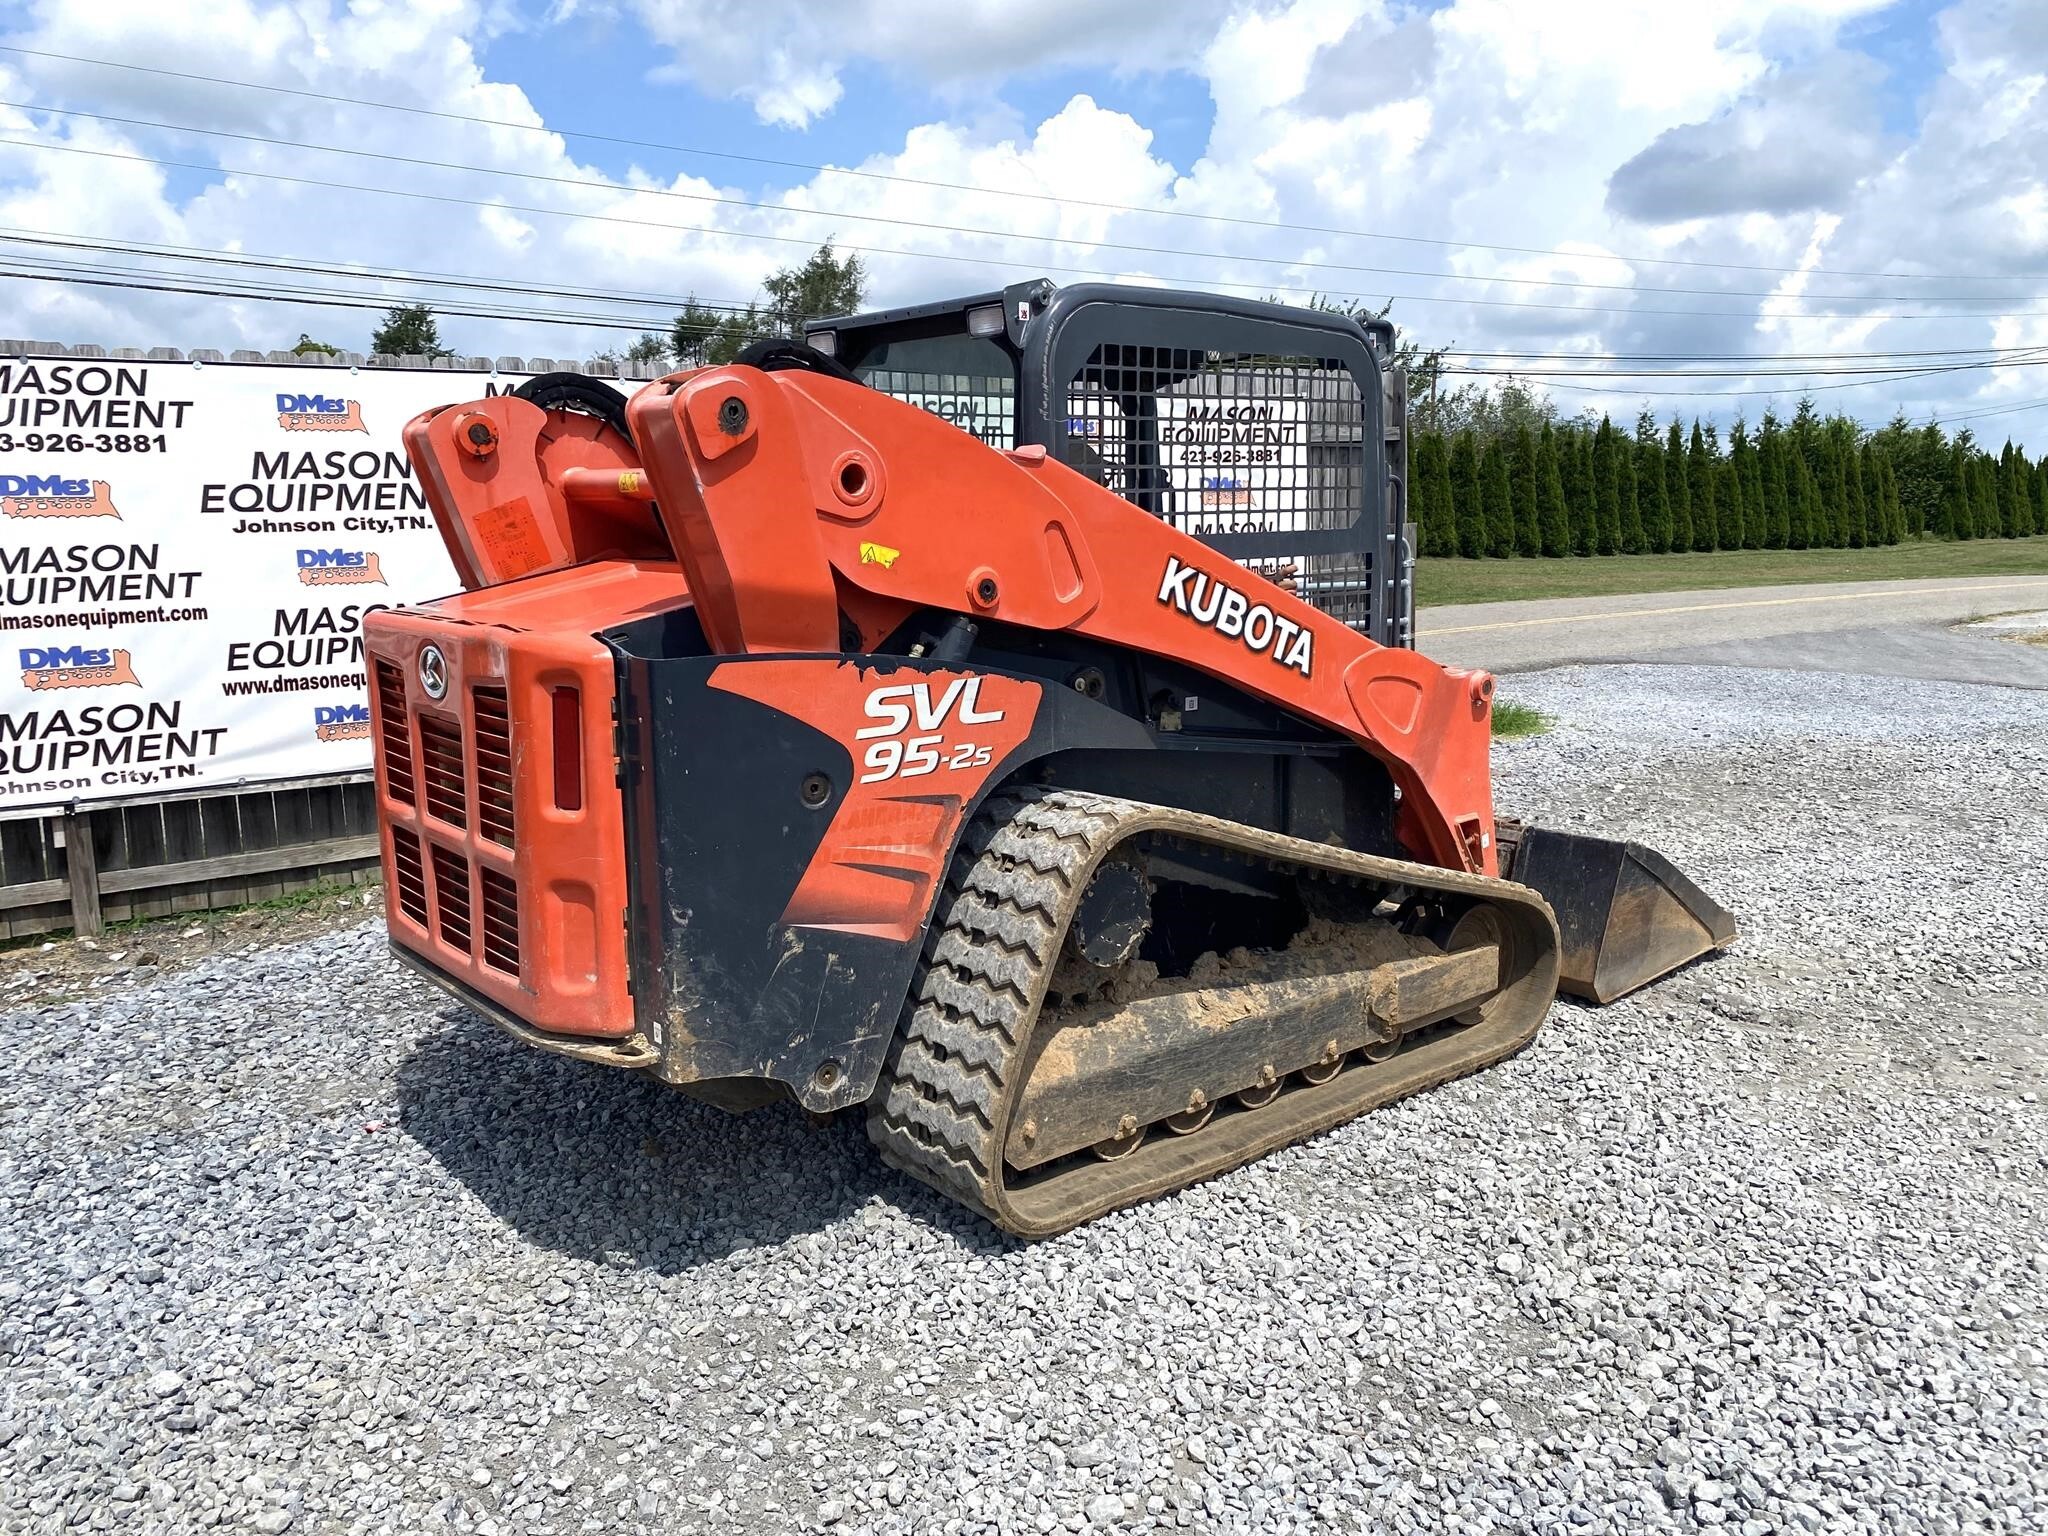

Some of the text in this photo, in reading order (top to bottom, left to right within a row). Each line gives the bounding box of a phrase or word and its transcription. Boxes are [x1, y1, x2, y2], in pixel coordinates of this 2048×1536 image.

[911, 400, 979, 422] SON
[1188, 406, 1273, 425] MASON
[0, 433, 167, 453] 3-926-3881
[1163, 427, 1294, 446] EQUIPMENT
[252, 451, 413, 480] MASON
[1180, 449, 1281, 463] 423-926-3881
[200, 483, 428, 514] EQUIPMEN
[232, 516, 433, 534] Johnson City,TN.
[0, 544, 159, 575] MASON
[0, 572, 202, 606] UIPMENT
[0, 606, 208, 631] masonequipment.com
[274, 604, 407, 637] MAS
[1158, 557, 1313, 676] KUBOTA
[0, 701, 181, 742] MASON
[855, 677, 1005, 740] SVL
[0, 728, 228, 775] UIPMENT
[101, 764, 203, 786] City,TN.
